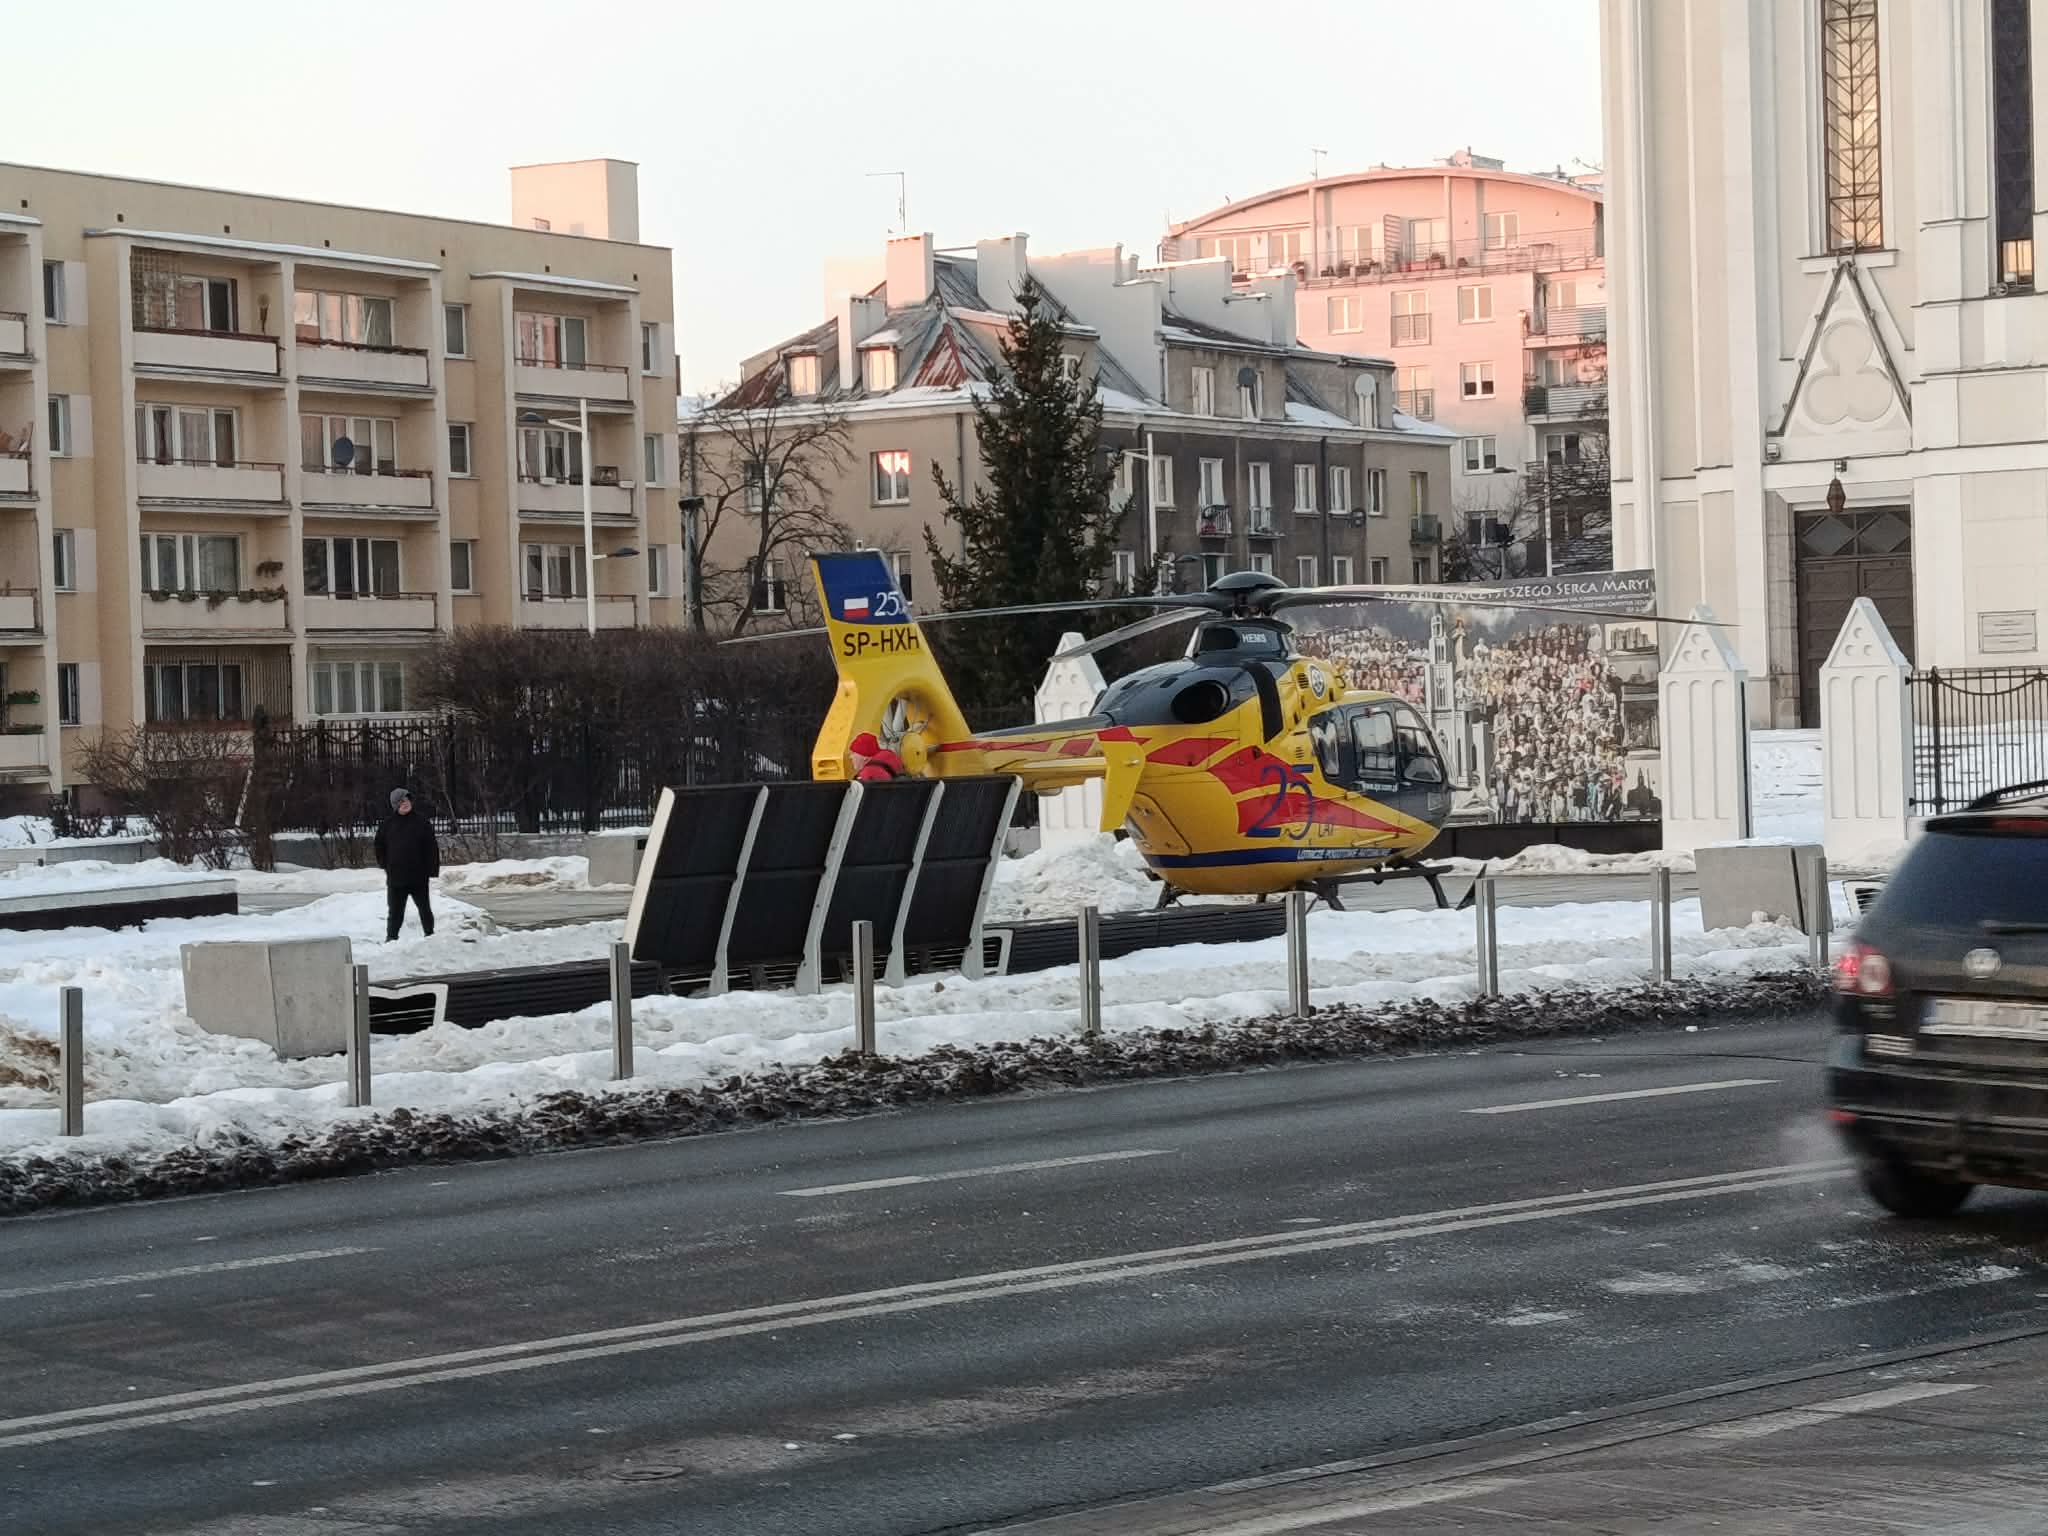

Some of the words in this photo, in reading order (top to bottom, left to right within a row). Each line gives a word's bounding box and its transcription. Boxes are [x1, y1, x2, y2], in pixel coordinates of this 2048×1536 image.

[1556, 582, 1598, 596] SERCA
[1602, 578, 1649, 593] MARYI
[874, 591, 900, 616] 25
[843, 627, 920, 656] SP-HXH
[1245, 763, 1315, 840] 25
